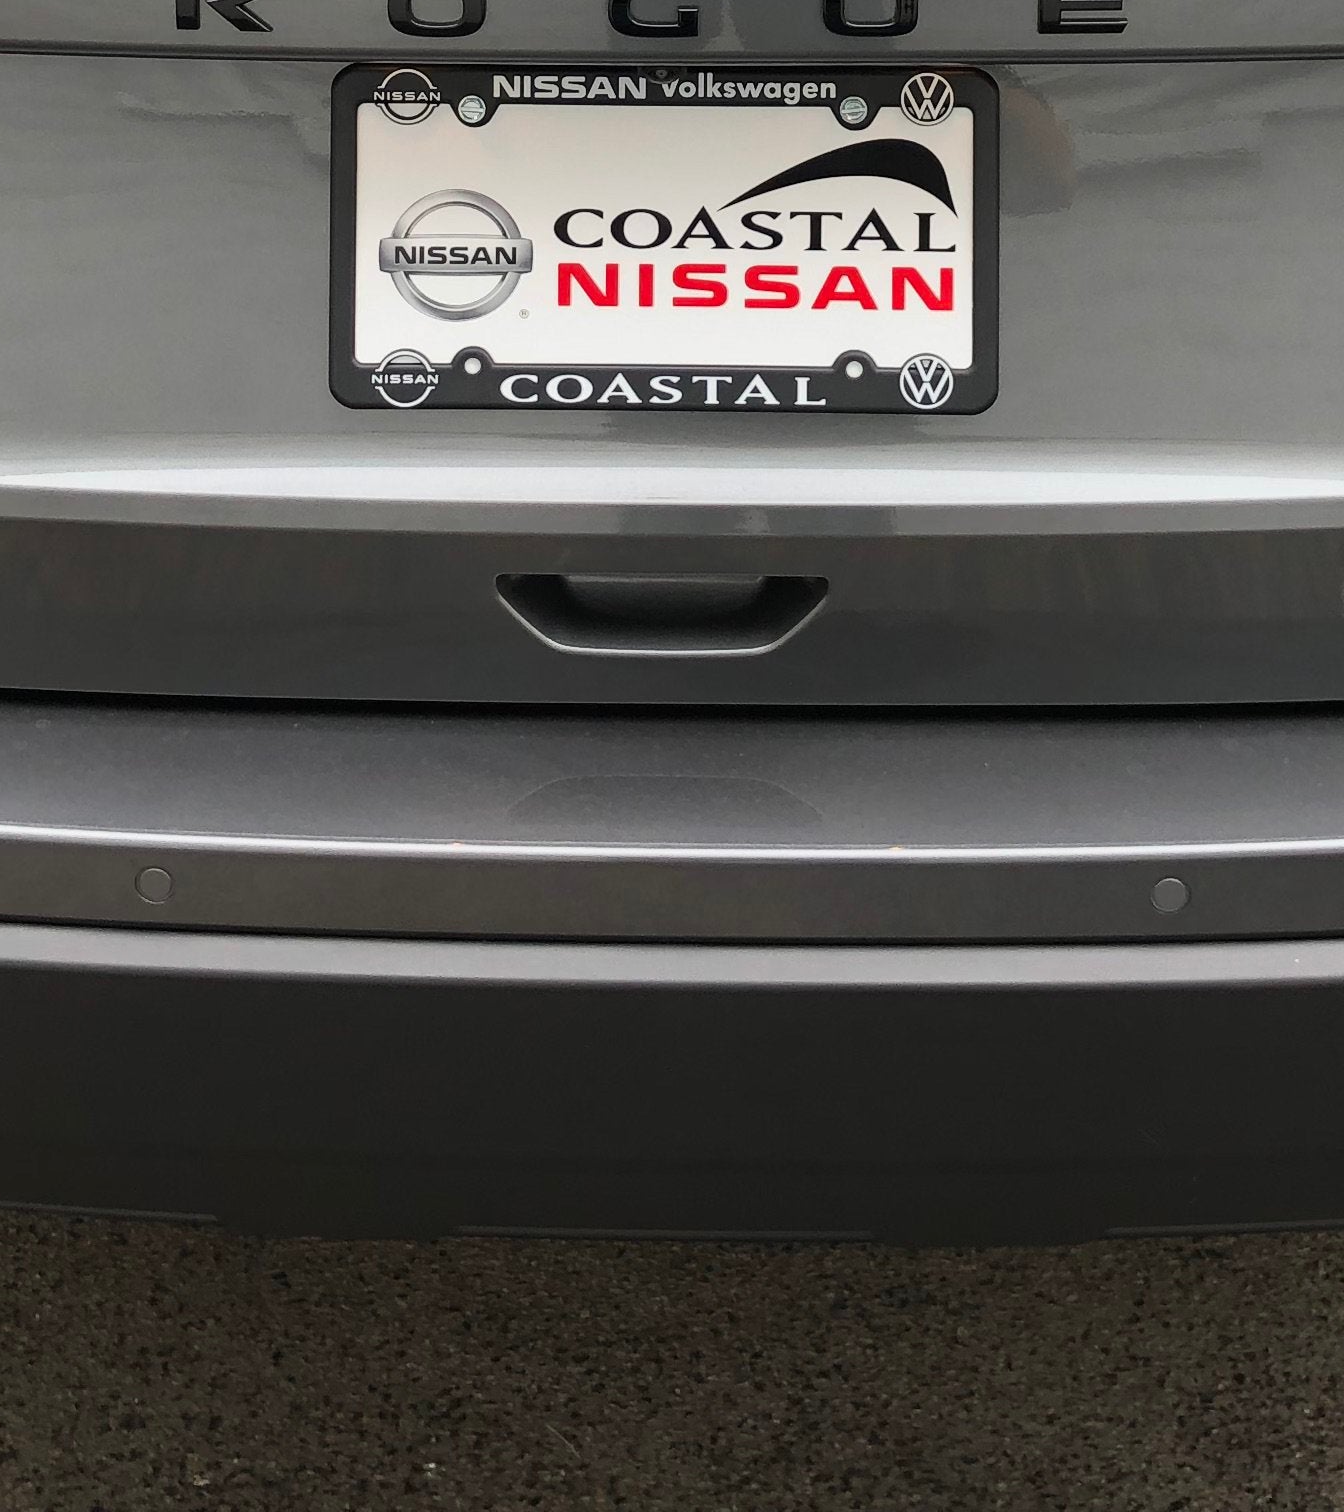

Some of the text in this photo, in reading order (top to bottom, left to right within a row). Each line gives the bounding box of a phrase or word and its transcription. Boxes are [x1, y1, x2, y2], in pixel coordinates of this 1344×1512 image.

[373, 91, 441, 102] NISSAN
[492, 75, 647, 99] NISSAN
[553, 205, 957, 253] COASTAL
[394, 245, 517, 265] NISSAN
[557, 262, 954, 311] NISSAN
[371, 374, 439, 384] NISSAN
[499, 372, 827, 406] COASTAL
